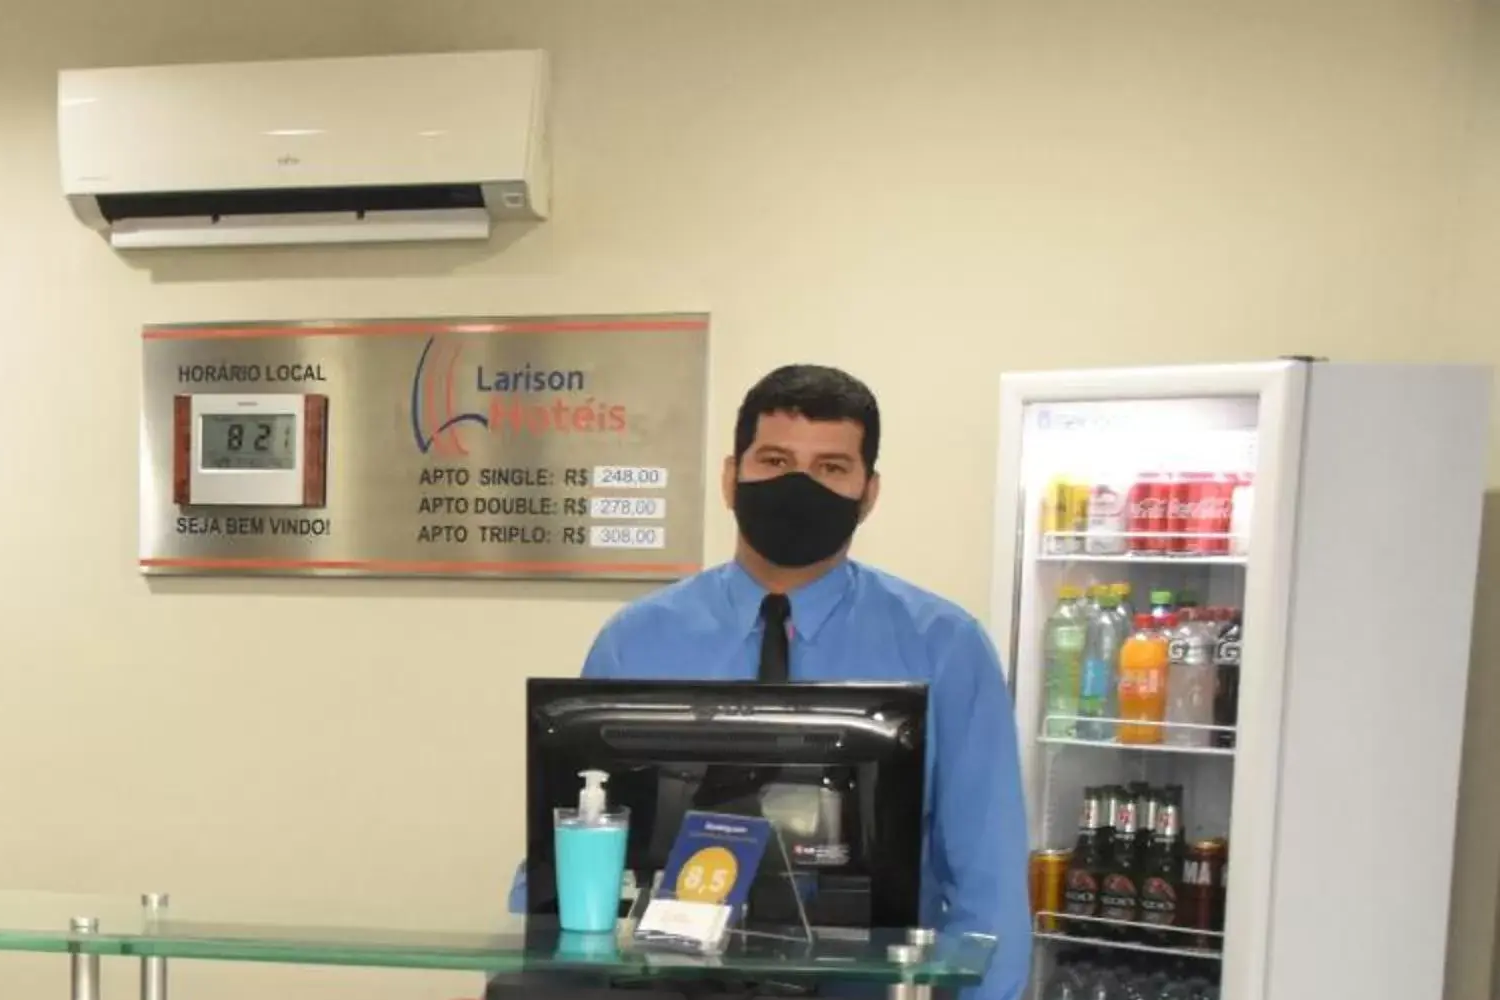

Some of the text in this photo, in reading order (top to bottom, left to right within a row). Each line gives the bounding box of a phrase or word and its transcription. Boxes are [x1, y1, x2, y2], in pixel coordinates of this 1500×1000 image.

[266, 363, 326, 381] LOCAL
[477, 362, 585, 393] Larison
[489, 395, 628, 434] Hotéis
[419, 467, 660, 487] APTO SINGLE: R$ 248,00
[418, 497, 657, 516] APTO DOUBLE: R$ 278,00
[176, 517, 331, 536] SEJA BEM VINDO!
[417, 525, 468, 544] APTO
[478, 525, 552, 544] TRIPLO:
[563, 527, 586, 545] R$
[684, 865, 729, 895] 8,5
